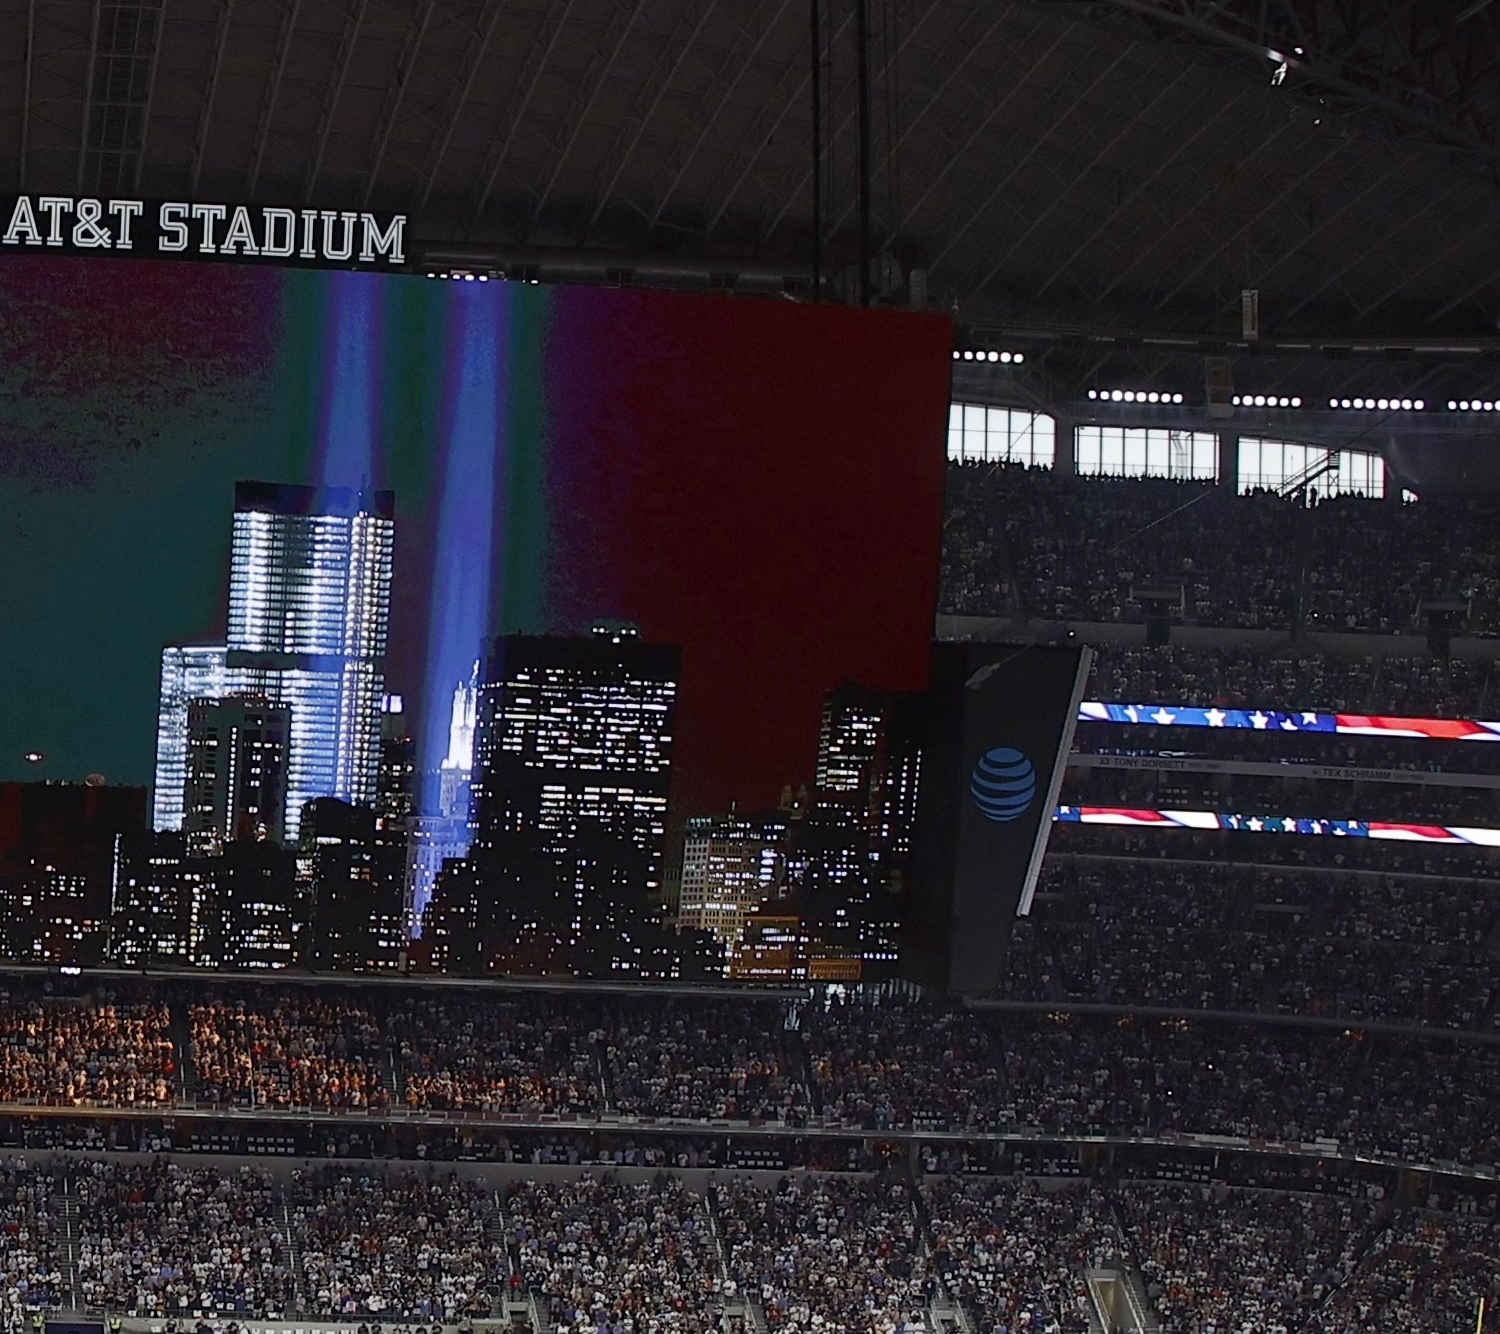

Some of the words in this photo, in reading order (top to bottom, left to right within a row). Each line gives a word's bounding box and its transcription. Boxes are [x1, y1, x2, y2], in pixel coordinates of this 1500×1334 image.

[2, 195, 143, 250] AT&T
[158, 202, 407, 264] STADIUM
[1114, 758, 1139, 767] TONY
[1141, 759, 1186, 769] DORSETT
[1322, 768, 1342, 777] TEX
[1344, 769, 1391, 780] SCHRAMM
